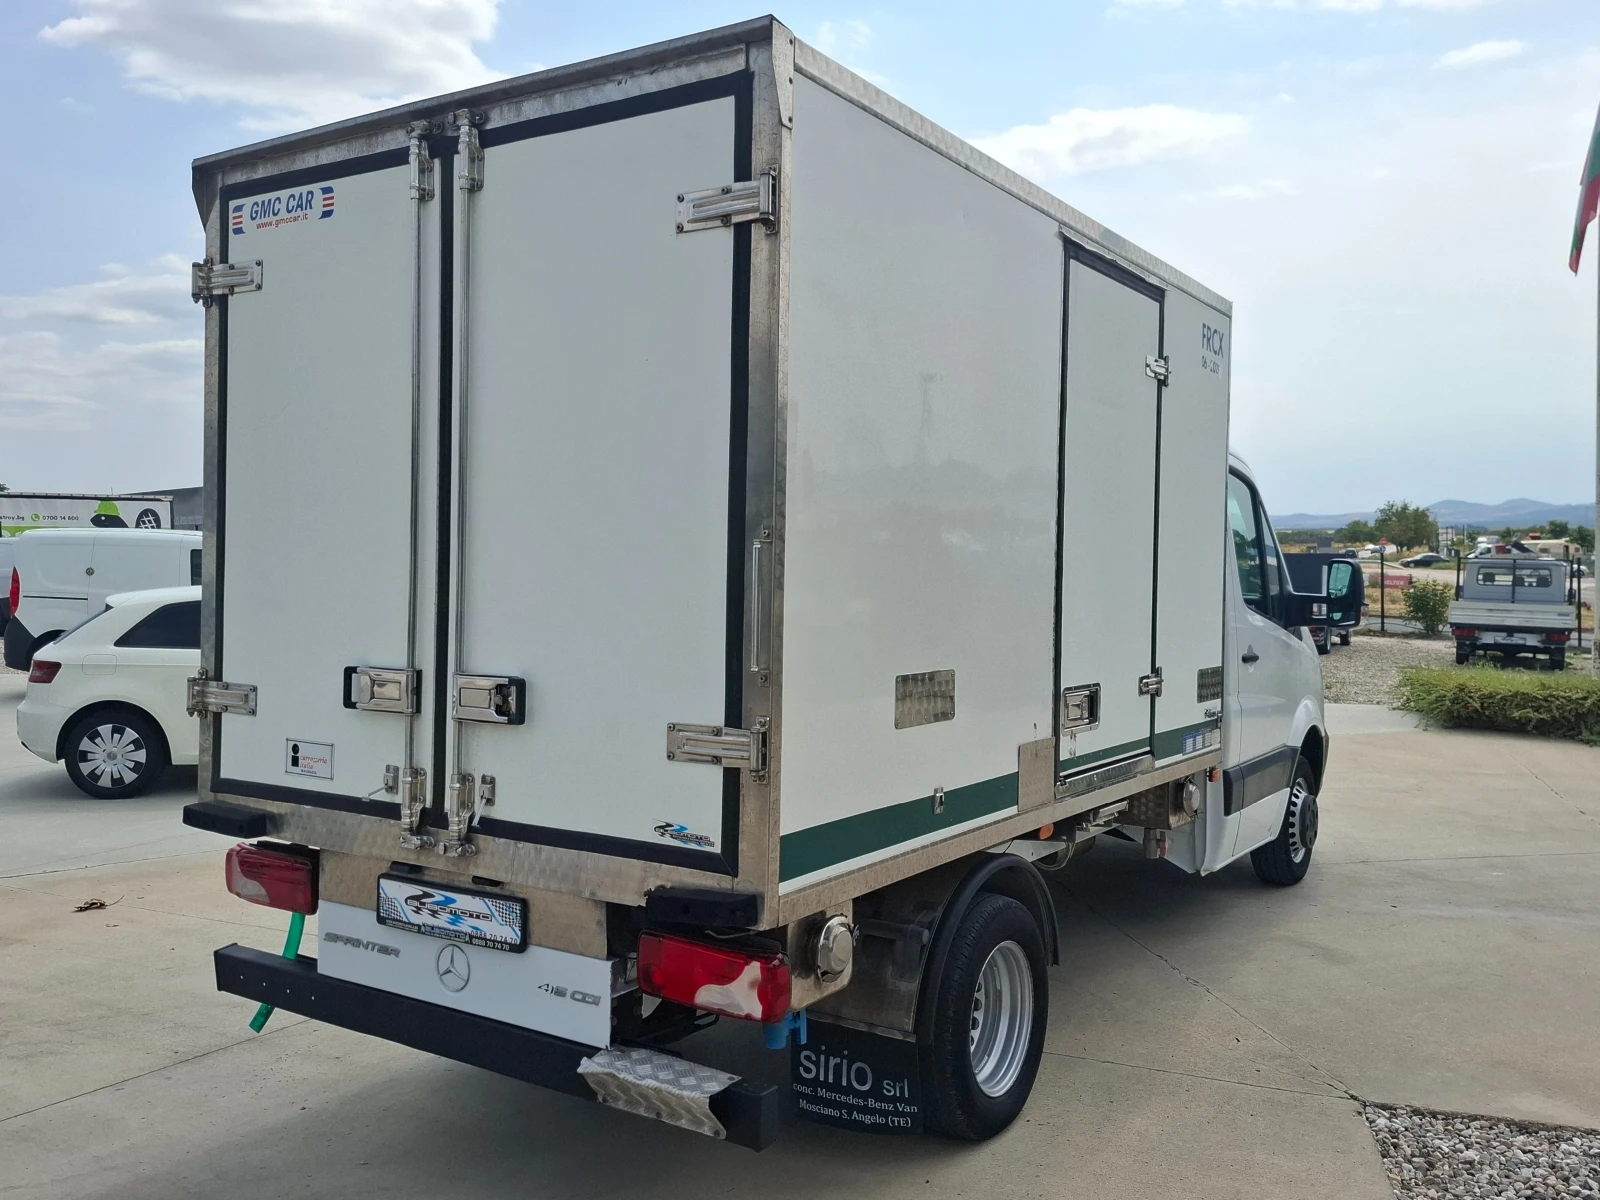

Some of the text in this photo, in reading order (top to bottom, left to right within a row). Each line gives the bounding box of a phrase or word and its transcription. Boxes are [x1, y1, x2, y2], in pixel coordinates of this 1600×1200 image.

[250, 190, 314, 221] GMC CAR
[256, 212, 308, 229] www.gmccar.it
[1202, 323, 1224, 359] FRCX
[323, 932, 401, 958] SPRINTER
[502, 943, 510, 951] 70
[570, 990, 601, 1006] CDI
[800, 1045, 909, 1098] sirio srl
[793, 1082, 918, 1113] conc. Mercedes-Benz Van
[799, 1099, 911, 1128] Mosciano S. Angelo (TE)
